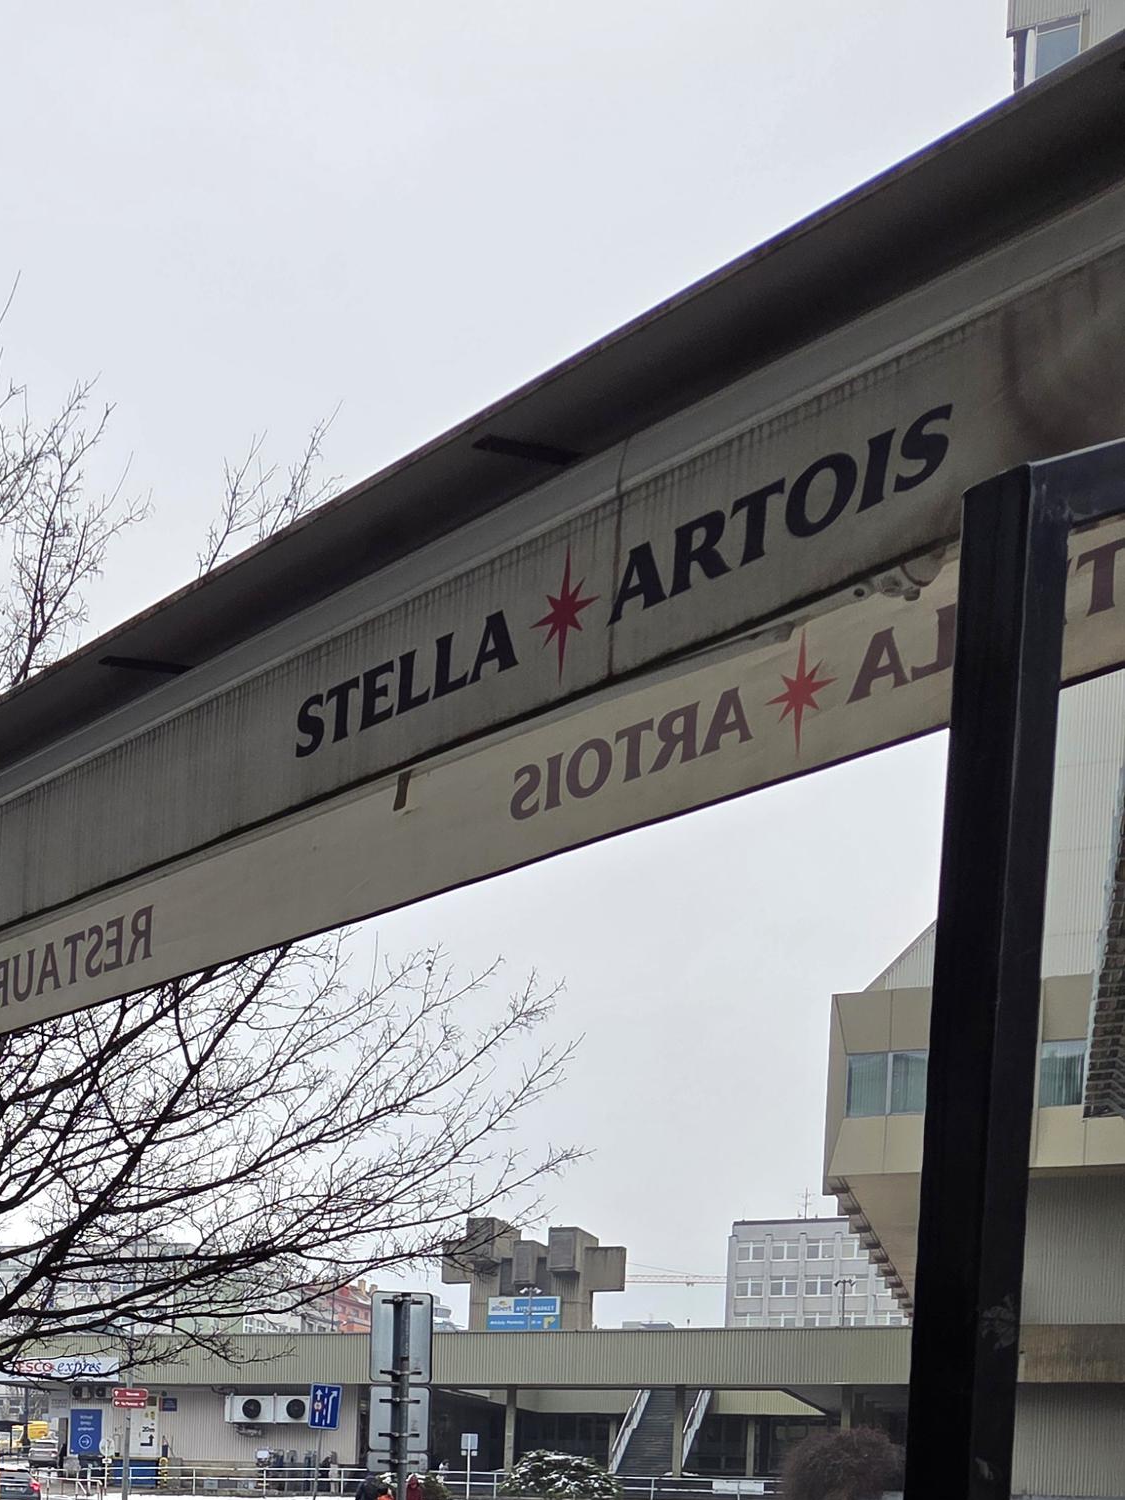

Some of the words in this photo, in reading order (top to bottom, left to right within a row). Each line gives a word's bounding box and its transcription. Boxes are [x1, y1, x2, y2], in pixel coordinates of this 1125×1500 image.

[295, 609, 519, 758] STELLA
[606, 403, 953, 627] ARTOIS
[12, 1359, 55, 1373] ESCO
[57, 1358, 102, 1375] expres
